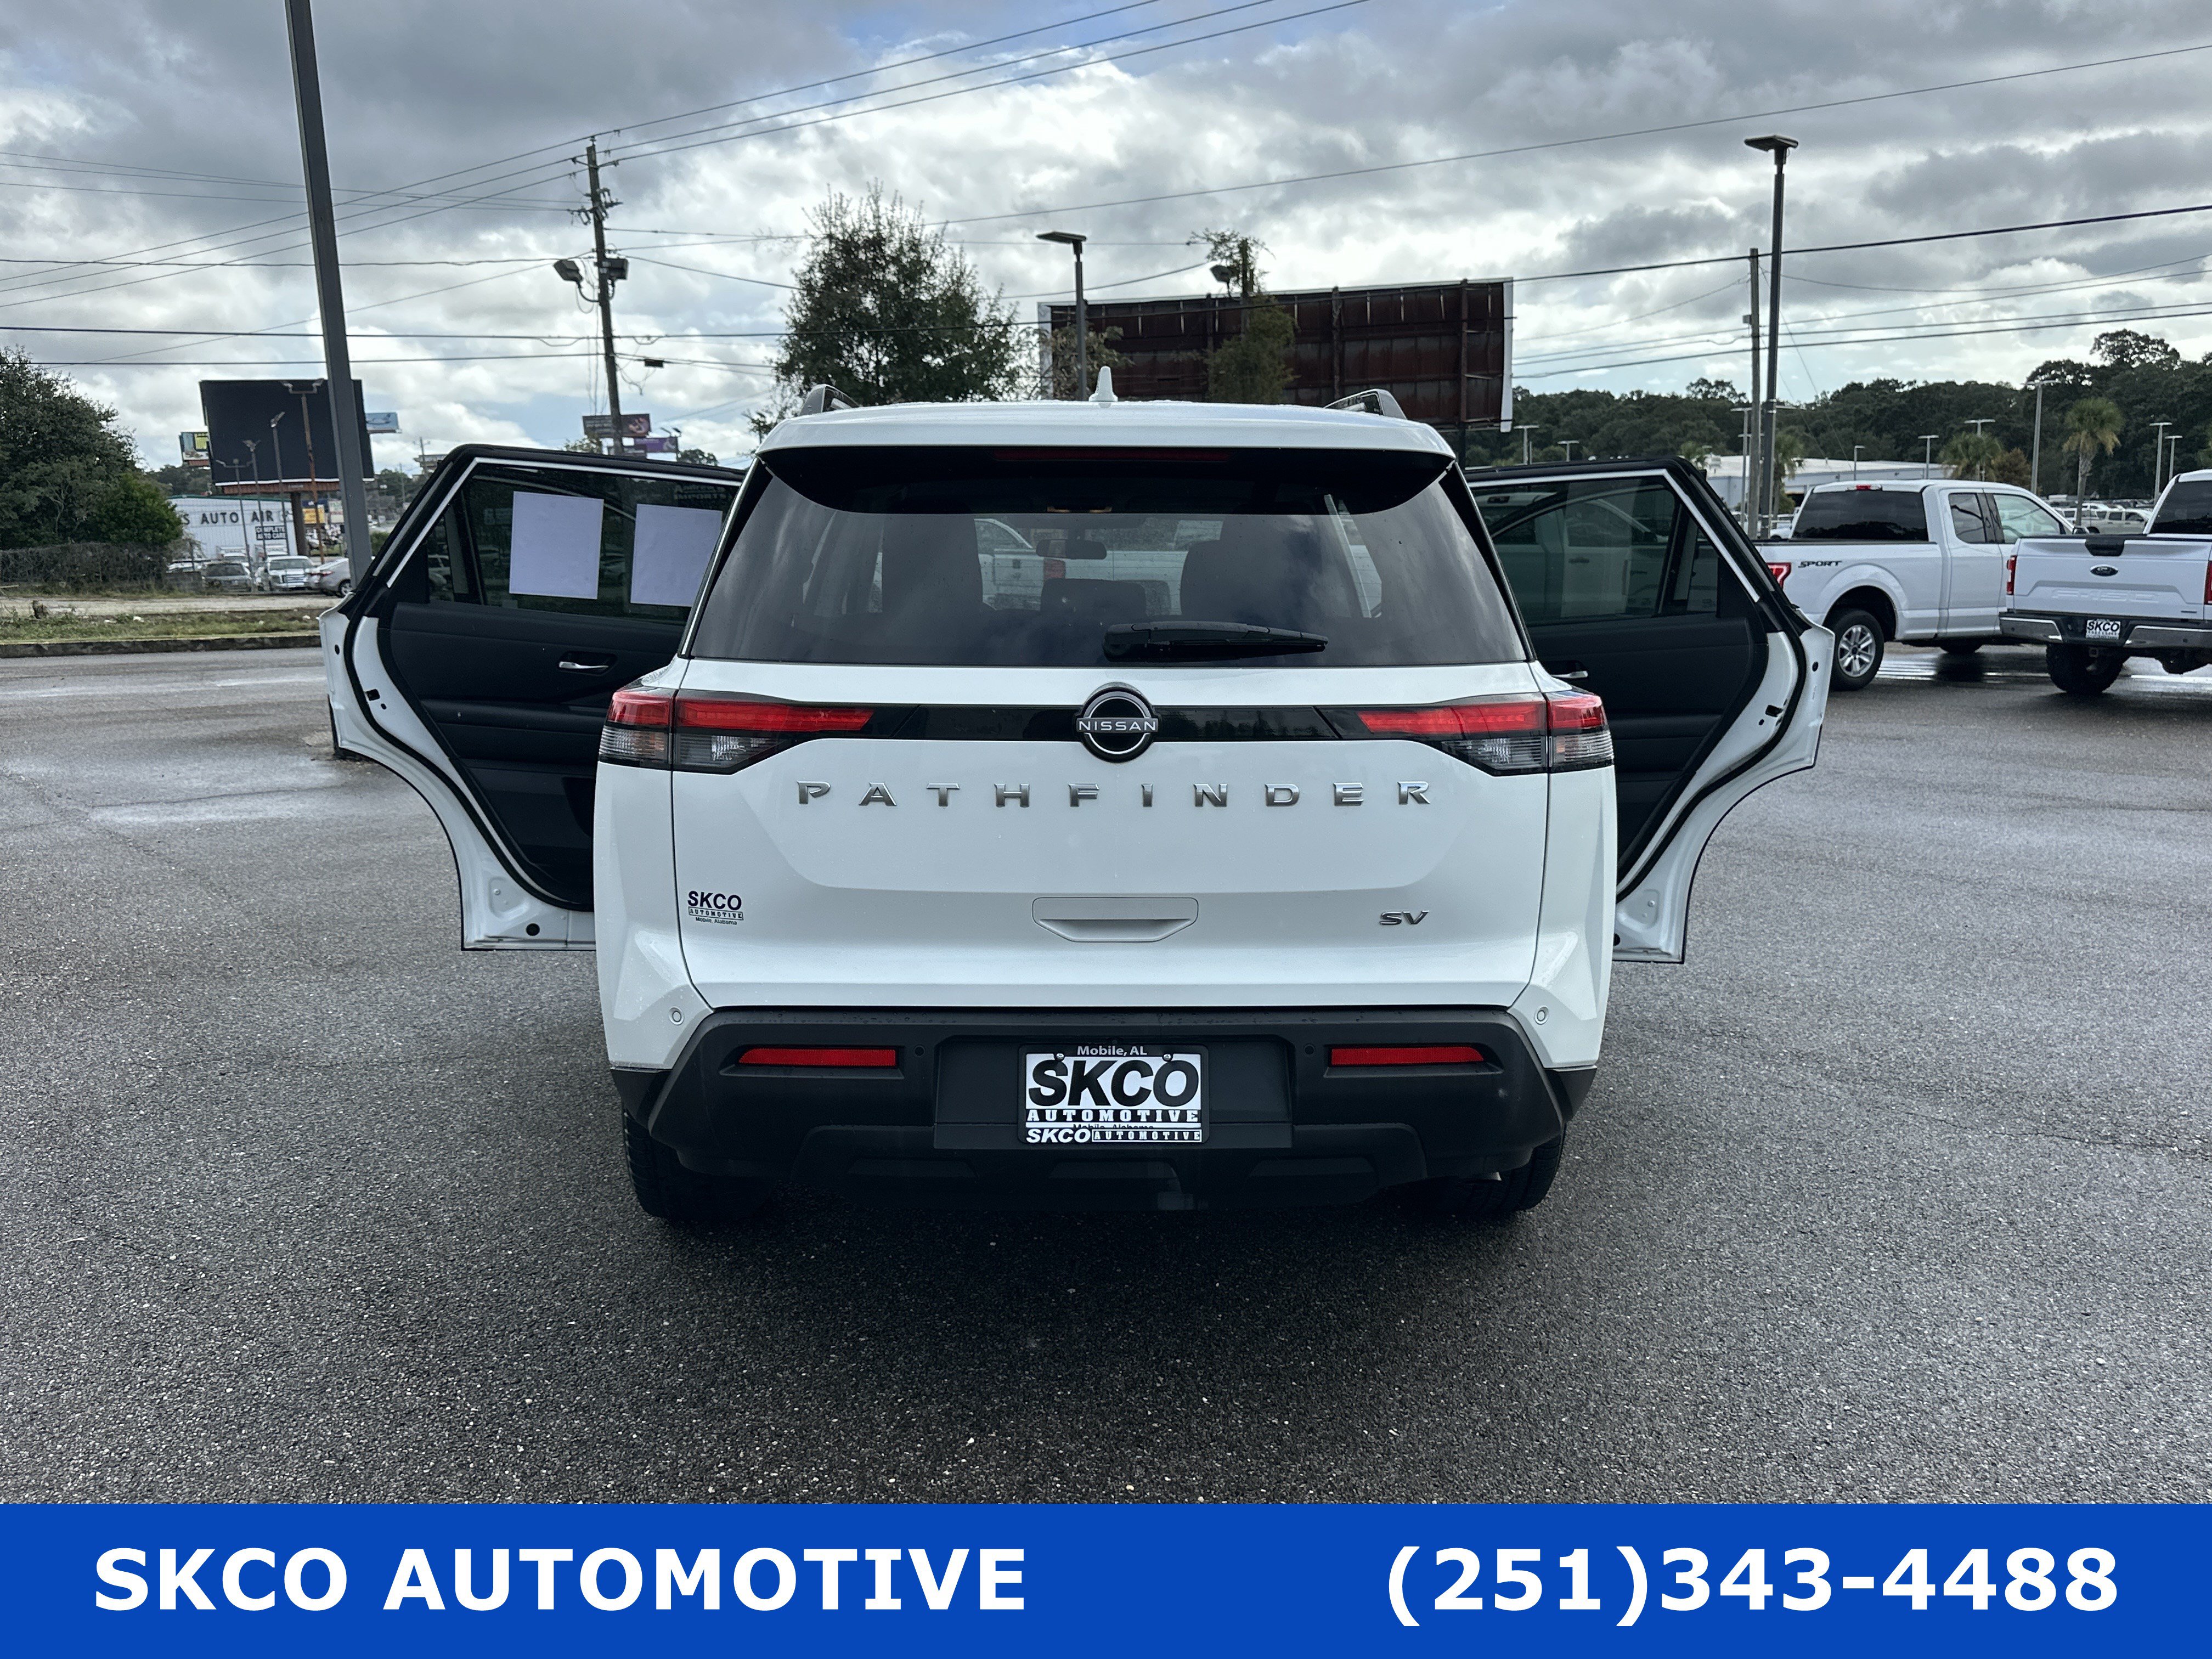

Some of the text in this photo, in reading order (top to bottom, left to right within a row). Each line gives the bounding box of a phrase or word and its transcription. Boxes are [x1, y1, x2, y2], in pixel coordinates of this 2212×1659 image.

[201, 512, 239, 524] AUTO
[251, 510, 274, 522] AIR
[2087, 621, 2119, 631] SKCO
[1079, 721, 1155, 731] NISSAN
[796, 781, 1431, 808] PATHFINDER
[687, 890, 742, 911] SKCO
[690, 909, 742, 918] AUTOMOTIVE
[1380, 910, 1430, 925] SV
[1077, 1046, 1147, 1056] Mobile, AL
[1028, 1059, 1199, 1107] SKCO
[1027, 1109, 1198, 1122] AUTOMOTIVE
[1026, 1128, 1200, 1143] SKCO AUTOMOTIVE
